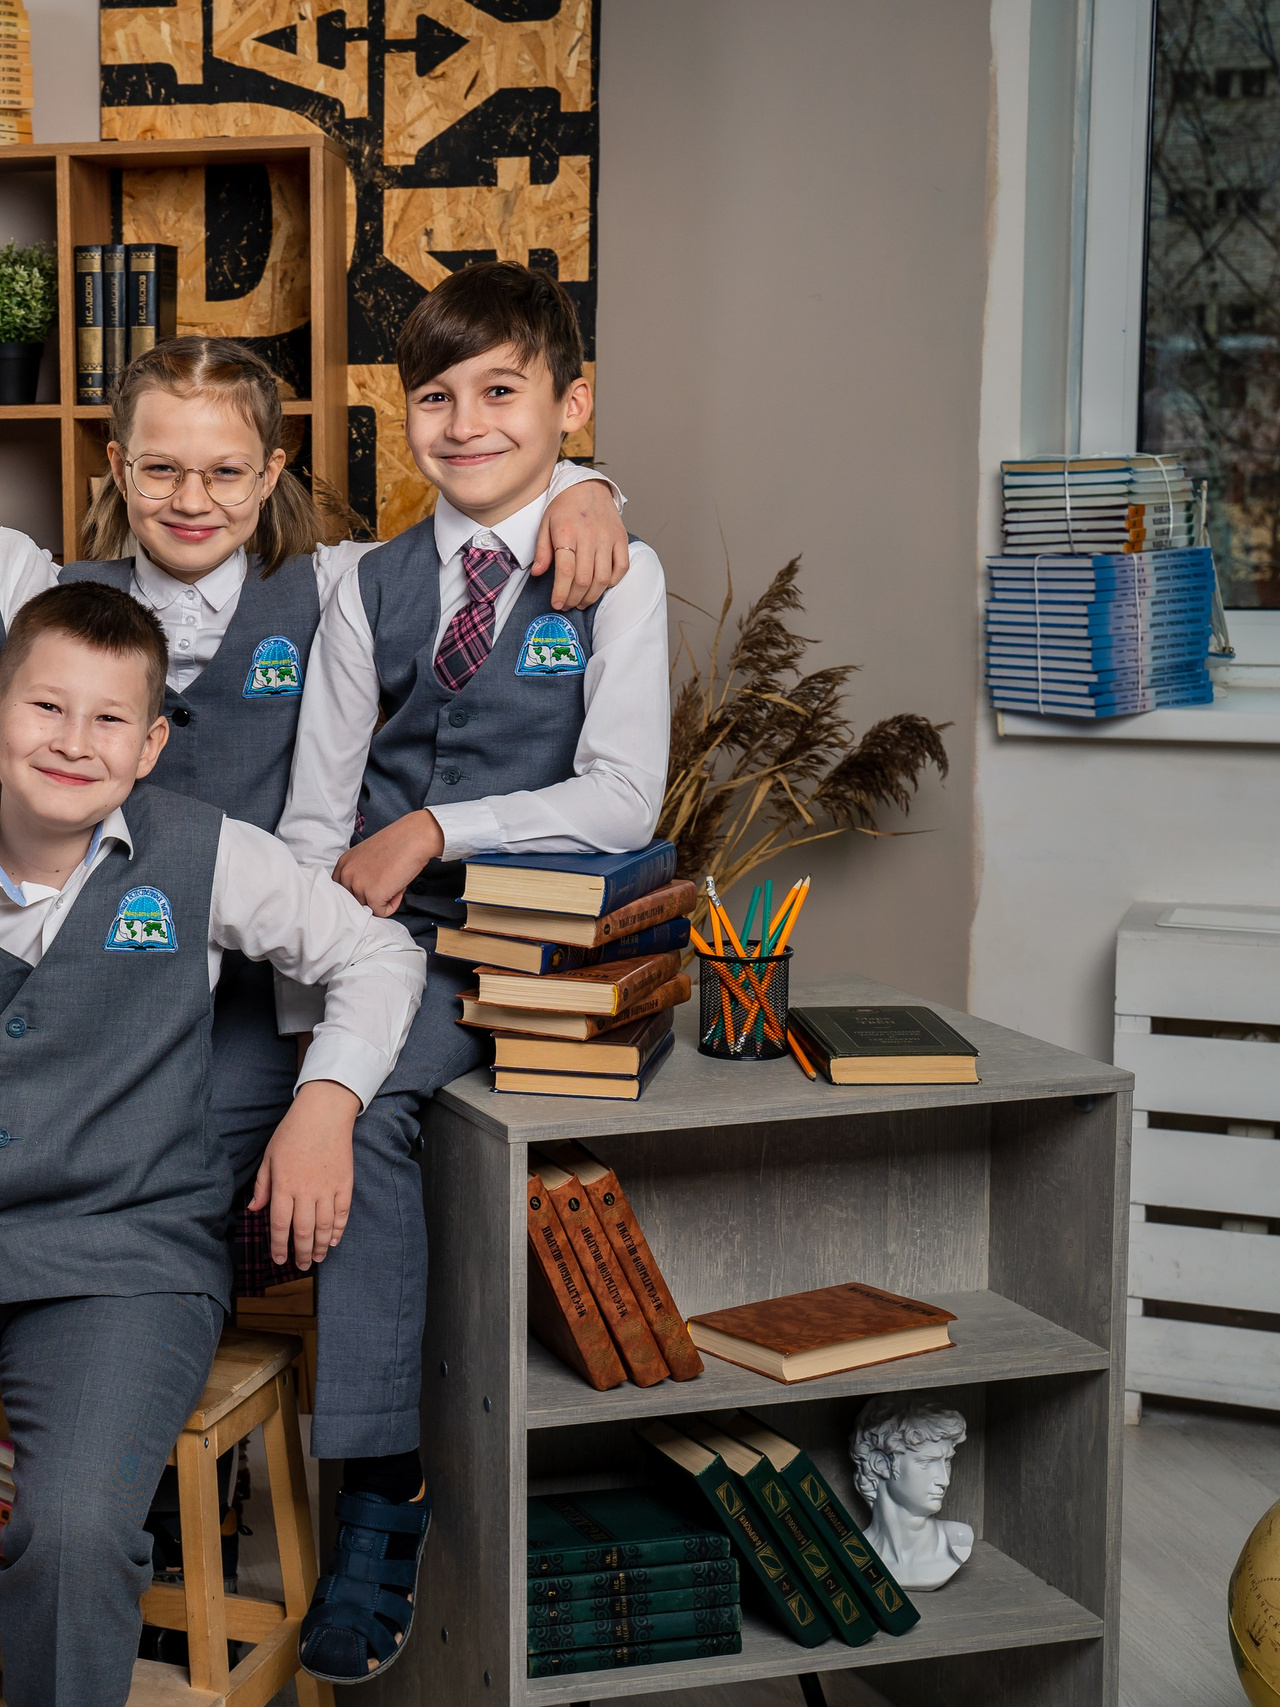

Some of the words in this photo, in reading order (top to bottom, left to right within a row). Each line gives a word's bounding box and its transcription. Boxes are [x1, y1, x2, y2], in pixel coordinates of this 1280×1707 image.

[86, 376, 93, 385] 4
[531, 1198, 539, 1209] 8
[570, 1198, 578, 1210] 4
[605, 1193, 614, 1205] 3
[781, 1580, 790, 1592] 4
[826, 1579, 835, 1590] 2
[549, 1610, 558, 1618] 5
